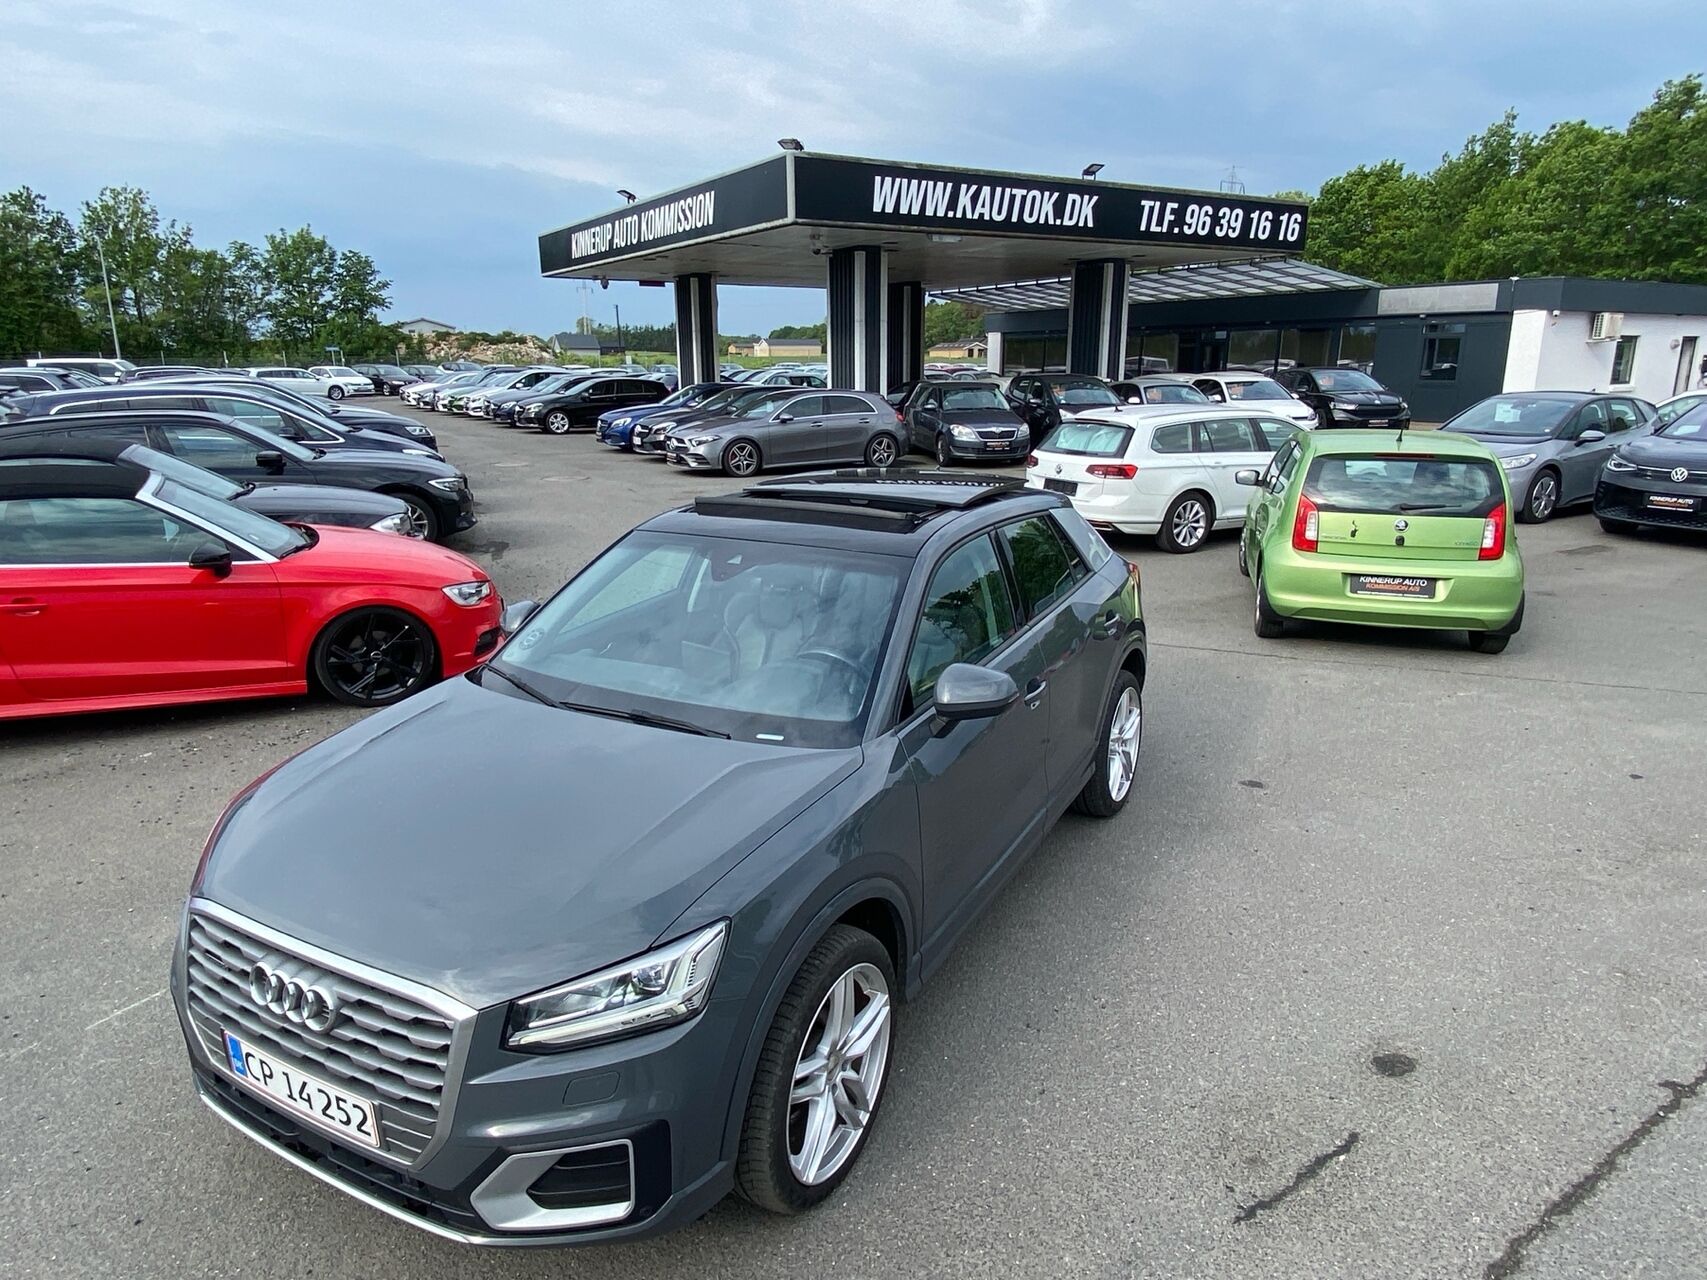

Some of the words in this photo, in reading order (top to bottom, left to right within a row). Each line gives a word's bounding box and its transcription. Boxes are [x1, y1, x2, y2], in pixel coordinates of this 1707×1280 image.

[872, 175, 1099, 228] WWW.KAUTOK.DK
[571, 222, 613, 259] KINNERUP
[613, 213, 640, 249] AUTO
[640, 190, 715, 243] KOMMISSION
[1183, 204, 1213, 236] 96
[1215, 206, 1244, 239] 39
[1249, 210, 1273, 240] 16
[1278, 212, 1302, 242] 16
[1359, 576, 1403, 585] KINNERUP
[1402, 579, 1428, 587] AUTO
[245, 1052, 274, 1086] CP
